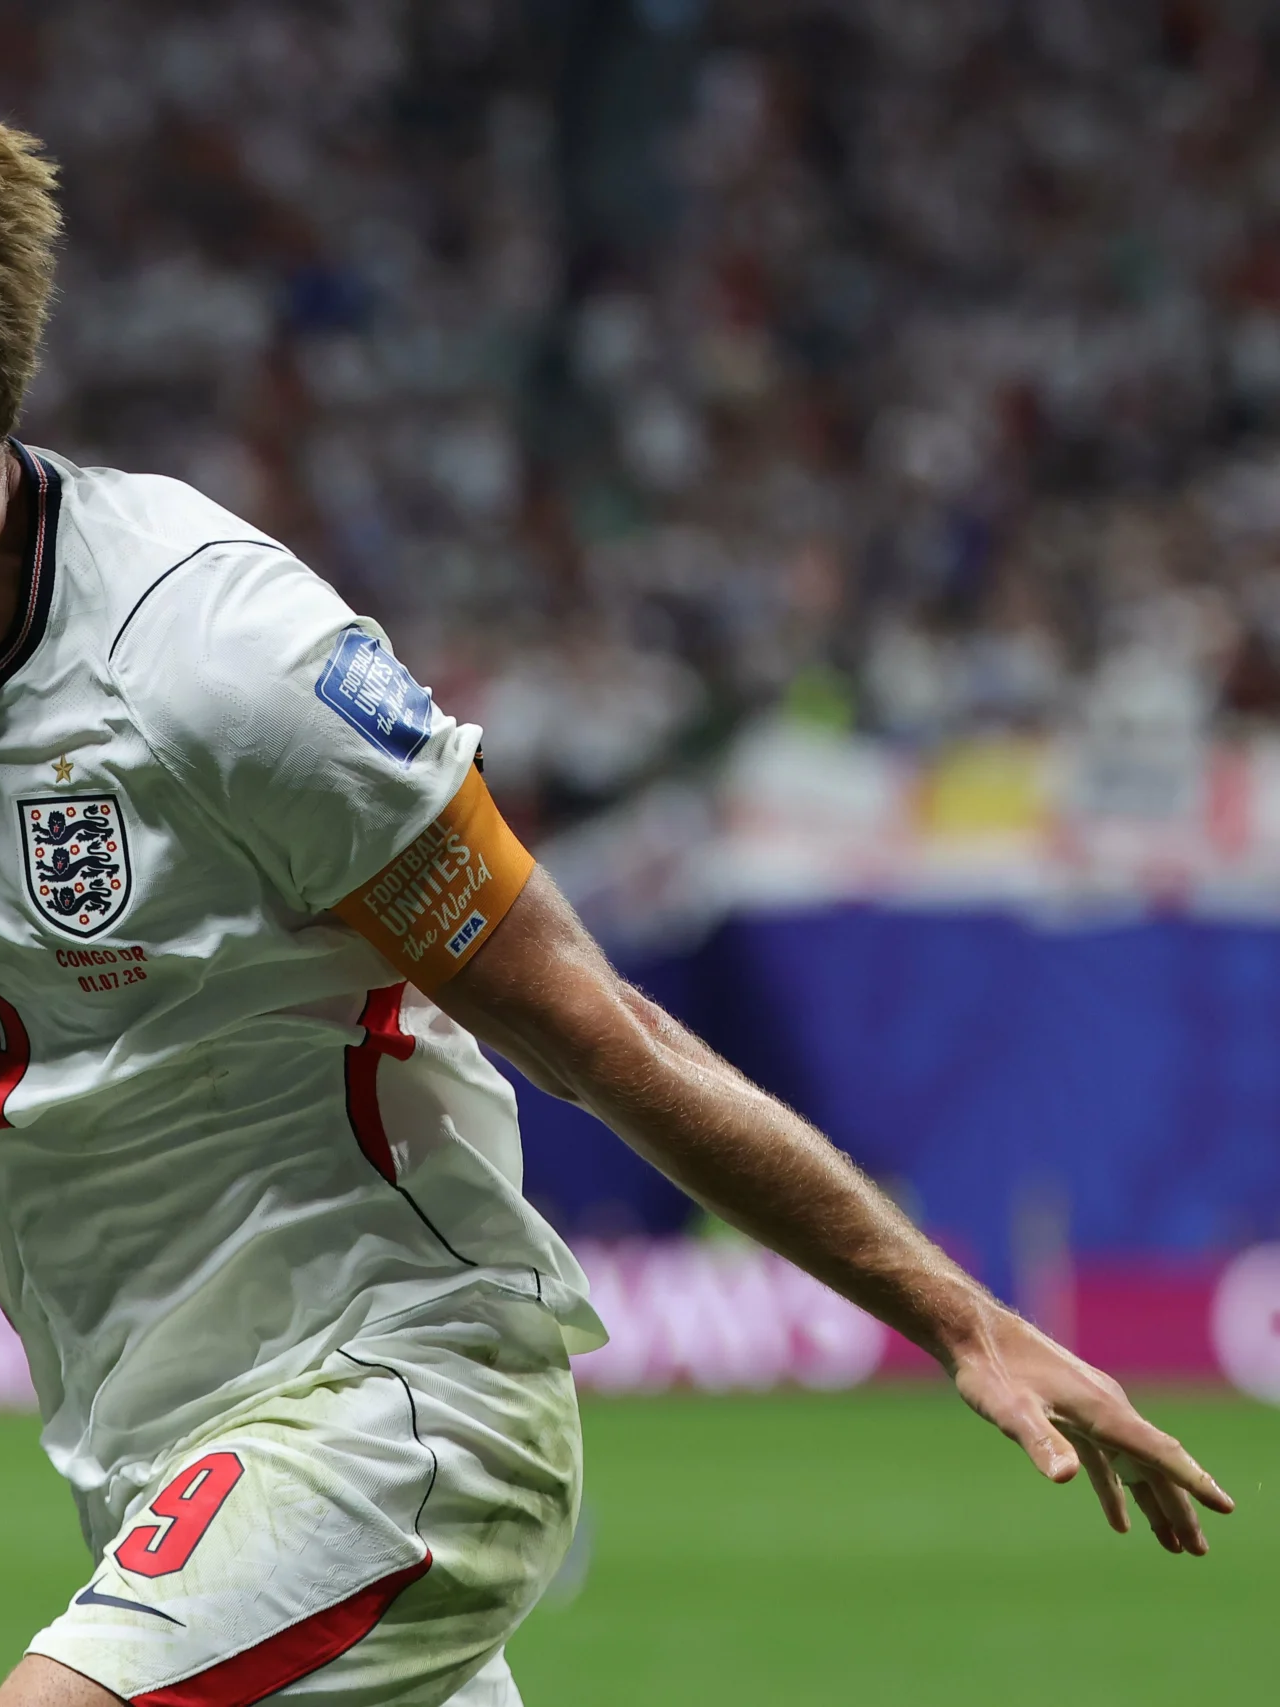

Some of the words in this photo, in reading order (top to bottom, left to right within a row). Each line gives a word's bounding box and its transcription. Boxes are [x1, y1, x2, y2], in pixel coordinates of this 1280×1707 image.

[339, 644, 374, 700] FOOTBALL
[354, 656, 393, 716] UNITES
[377, 712, 397, 736] the
[363, 820, 453, 914] FOOTBALL
[380, 834, 470, 936] UNITES
[402, 929, 438, 962] the
[431, 853, 492, 930] World
[450, 917, 484, 953] FIFA
[56, 949, 117, 968] CONGO
[117, 946, 148, 961] DR
[78, 967, 147, 992] 01.07.26
[114, 1452, 245, 1578] 9
